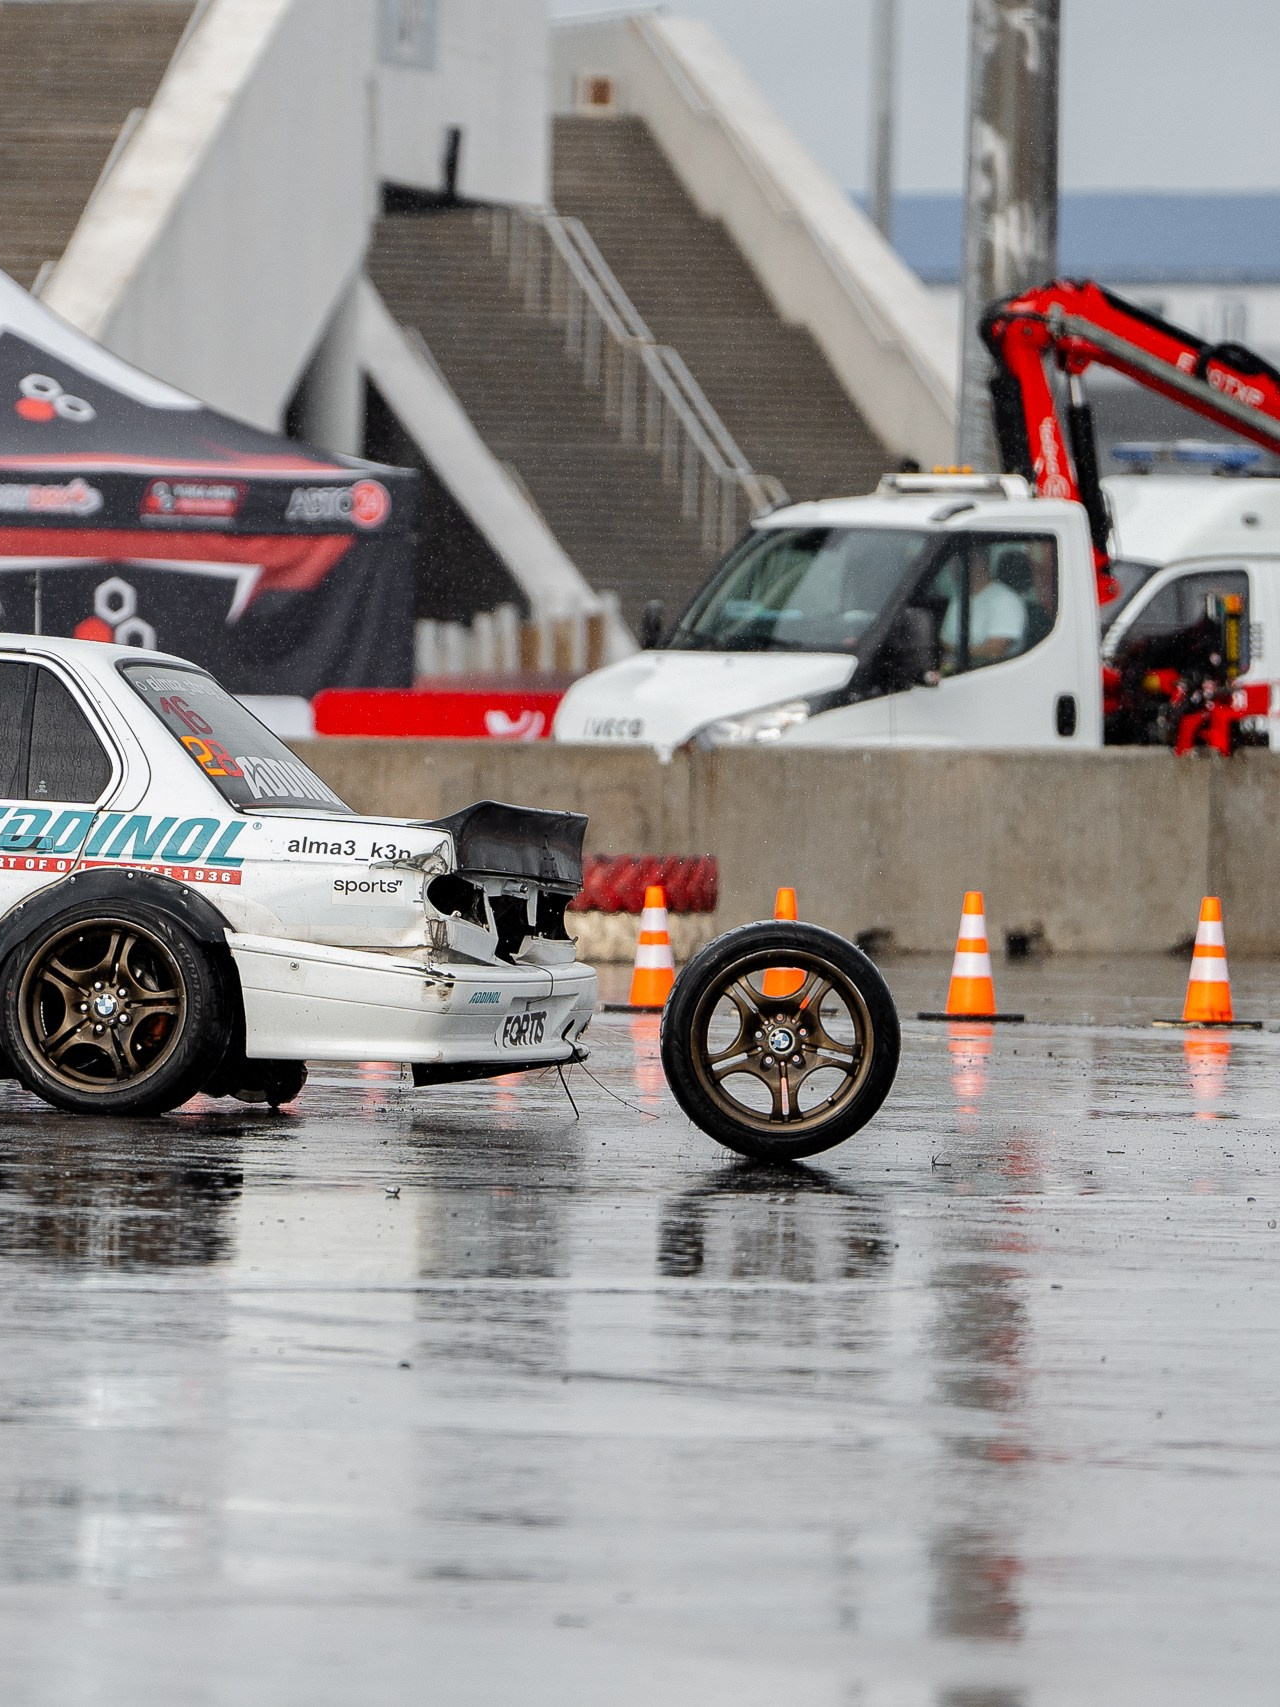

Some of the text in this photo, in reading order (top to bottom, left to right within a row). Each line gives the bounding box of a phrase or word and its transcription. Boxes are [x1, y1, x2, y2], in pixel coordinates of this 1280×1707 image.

[159, 696, 213, 735] 16
[25, 859, 48, 870] OF
[183, 869, 231, 883] 1936
[468, 991, 501, 1004] ADDINOL
